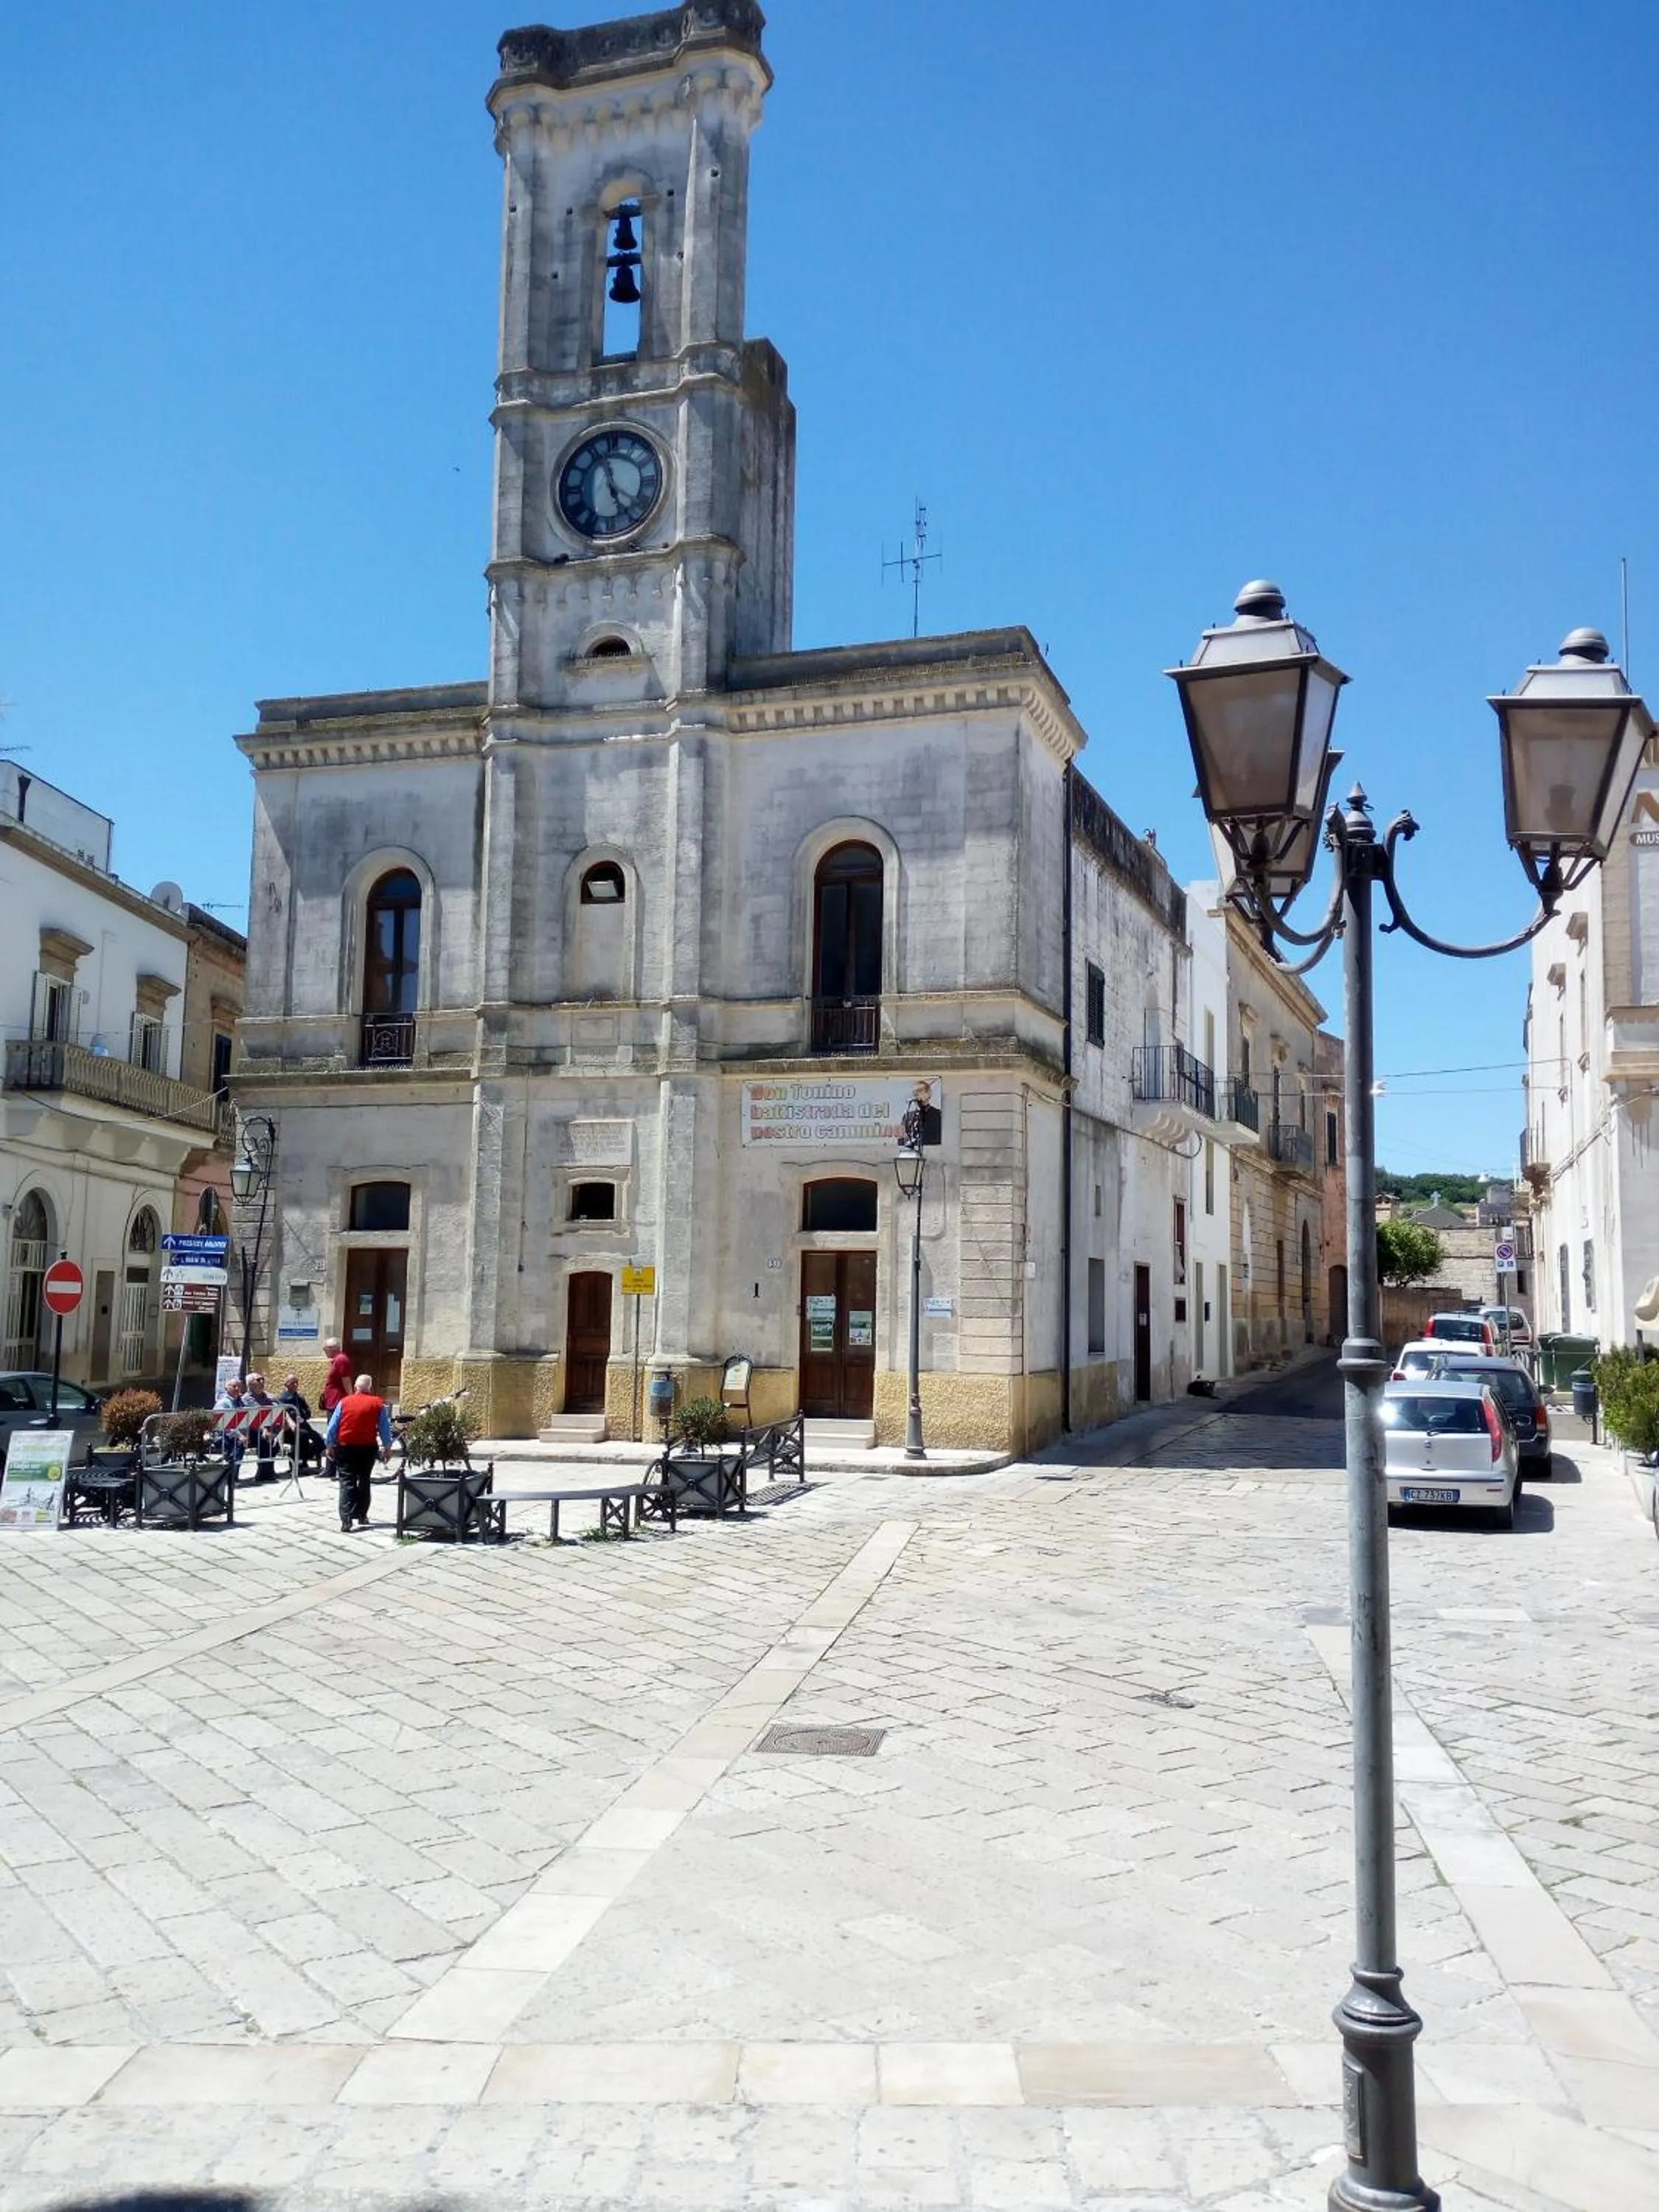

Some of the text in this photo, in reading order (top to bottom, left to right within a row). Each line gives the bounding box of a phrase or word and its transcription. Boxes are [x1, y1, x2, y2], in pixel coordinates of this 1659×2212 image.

[790, 1083, 855, 1100] Tonino
[751, 1102, 890, 1119] battistrada del
[751, 1124, 811, 1139] nostro
